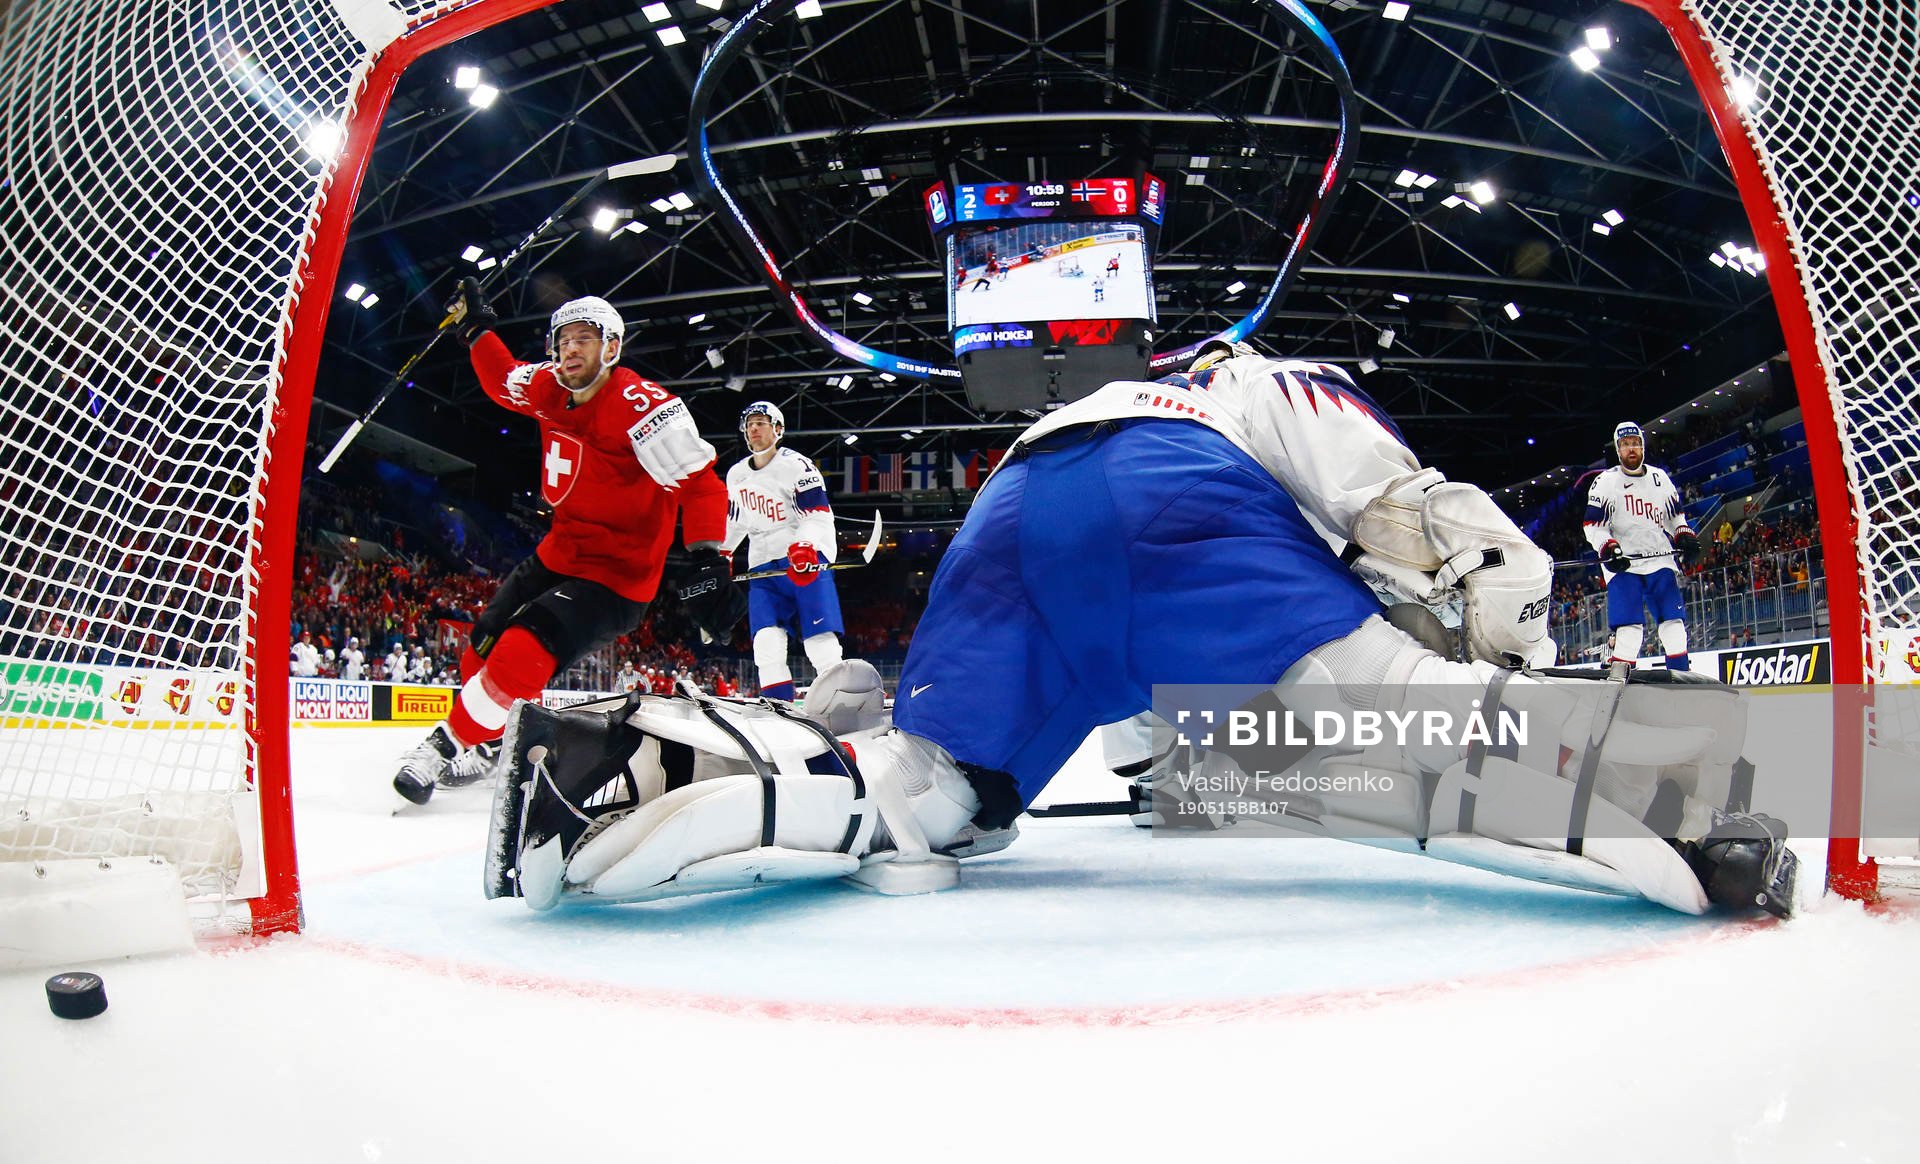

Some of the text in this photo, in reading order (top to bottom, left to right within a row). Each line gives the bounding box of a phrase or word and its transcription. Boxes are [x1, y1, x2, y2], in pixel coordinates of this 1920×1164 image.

[1025, 184, 1065, 196] 10:59
[1113, 187, 1127, 203] 0
[964, 193, 977, 209] 2
[560, 306, 589, 318] ZURICH
[993, 329, 1034, 342] HOKEJI
[648, 402, 683, 427] TISSOT
[1652, 472, 1661, 487] C
[739, 488, 787, 522] NORGE
[1731, 648, 1812, 686] isostar
[296, 683, 330, 701] LIQUI
[337, 685, 367, 702] LIQUI
[296, 701, 331, 719] MOLY
[336, 702, 368, 719] MOLY
[397, 693, 448, 713] PIRELLI
